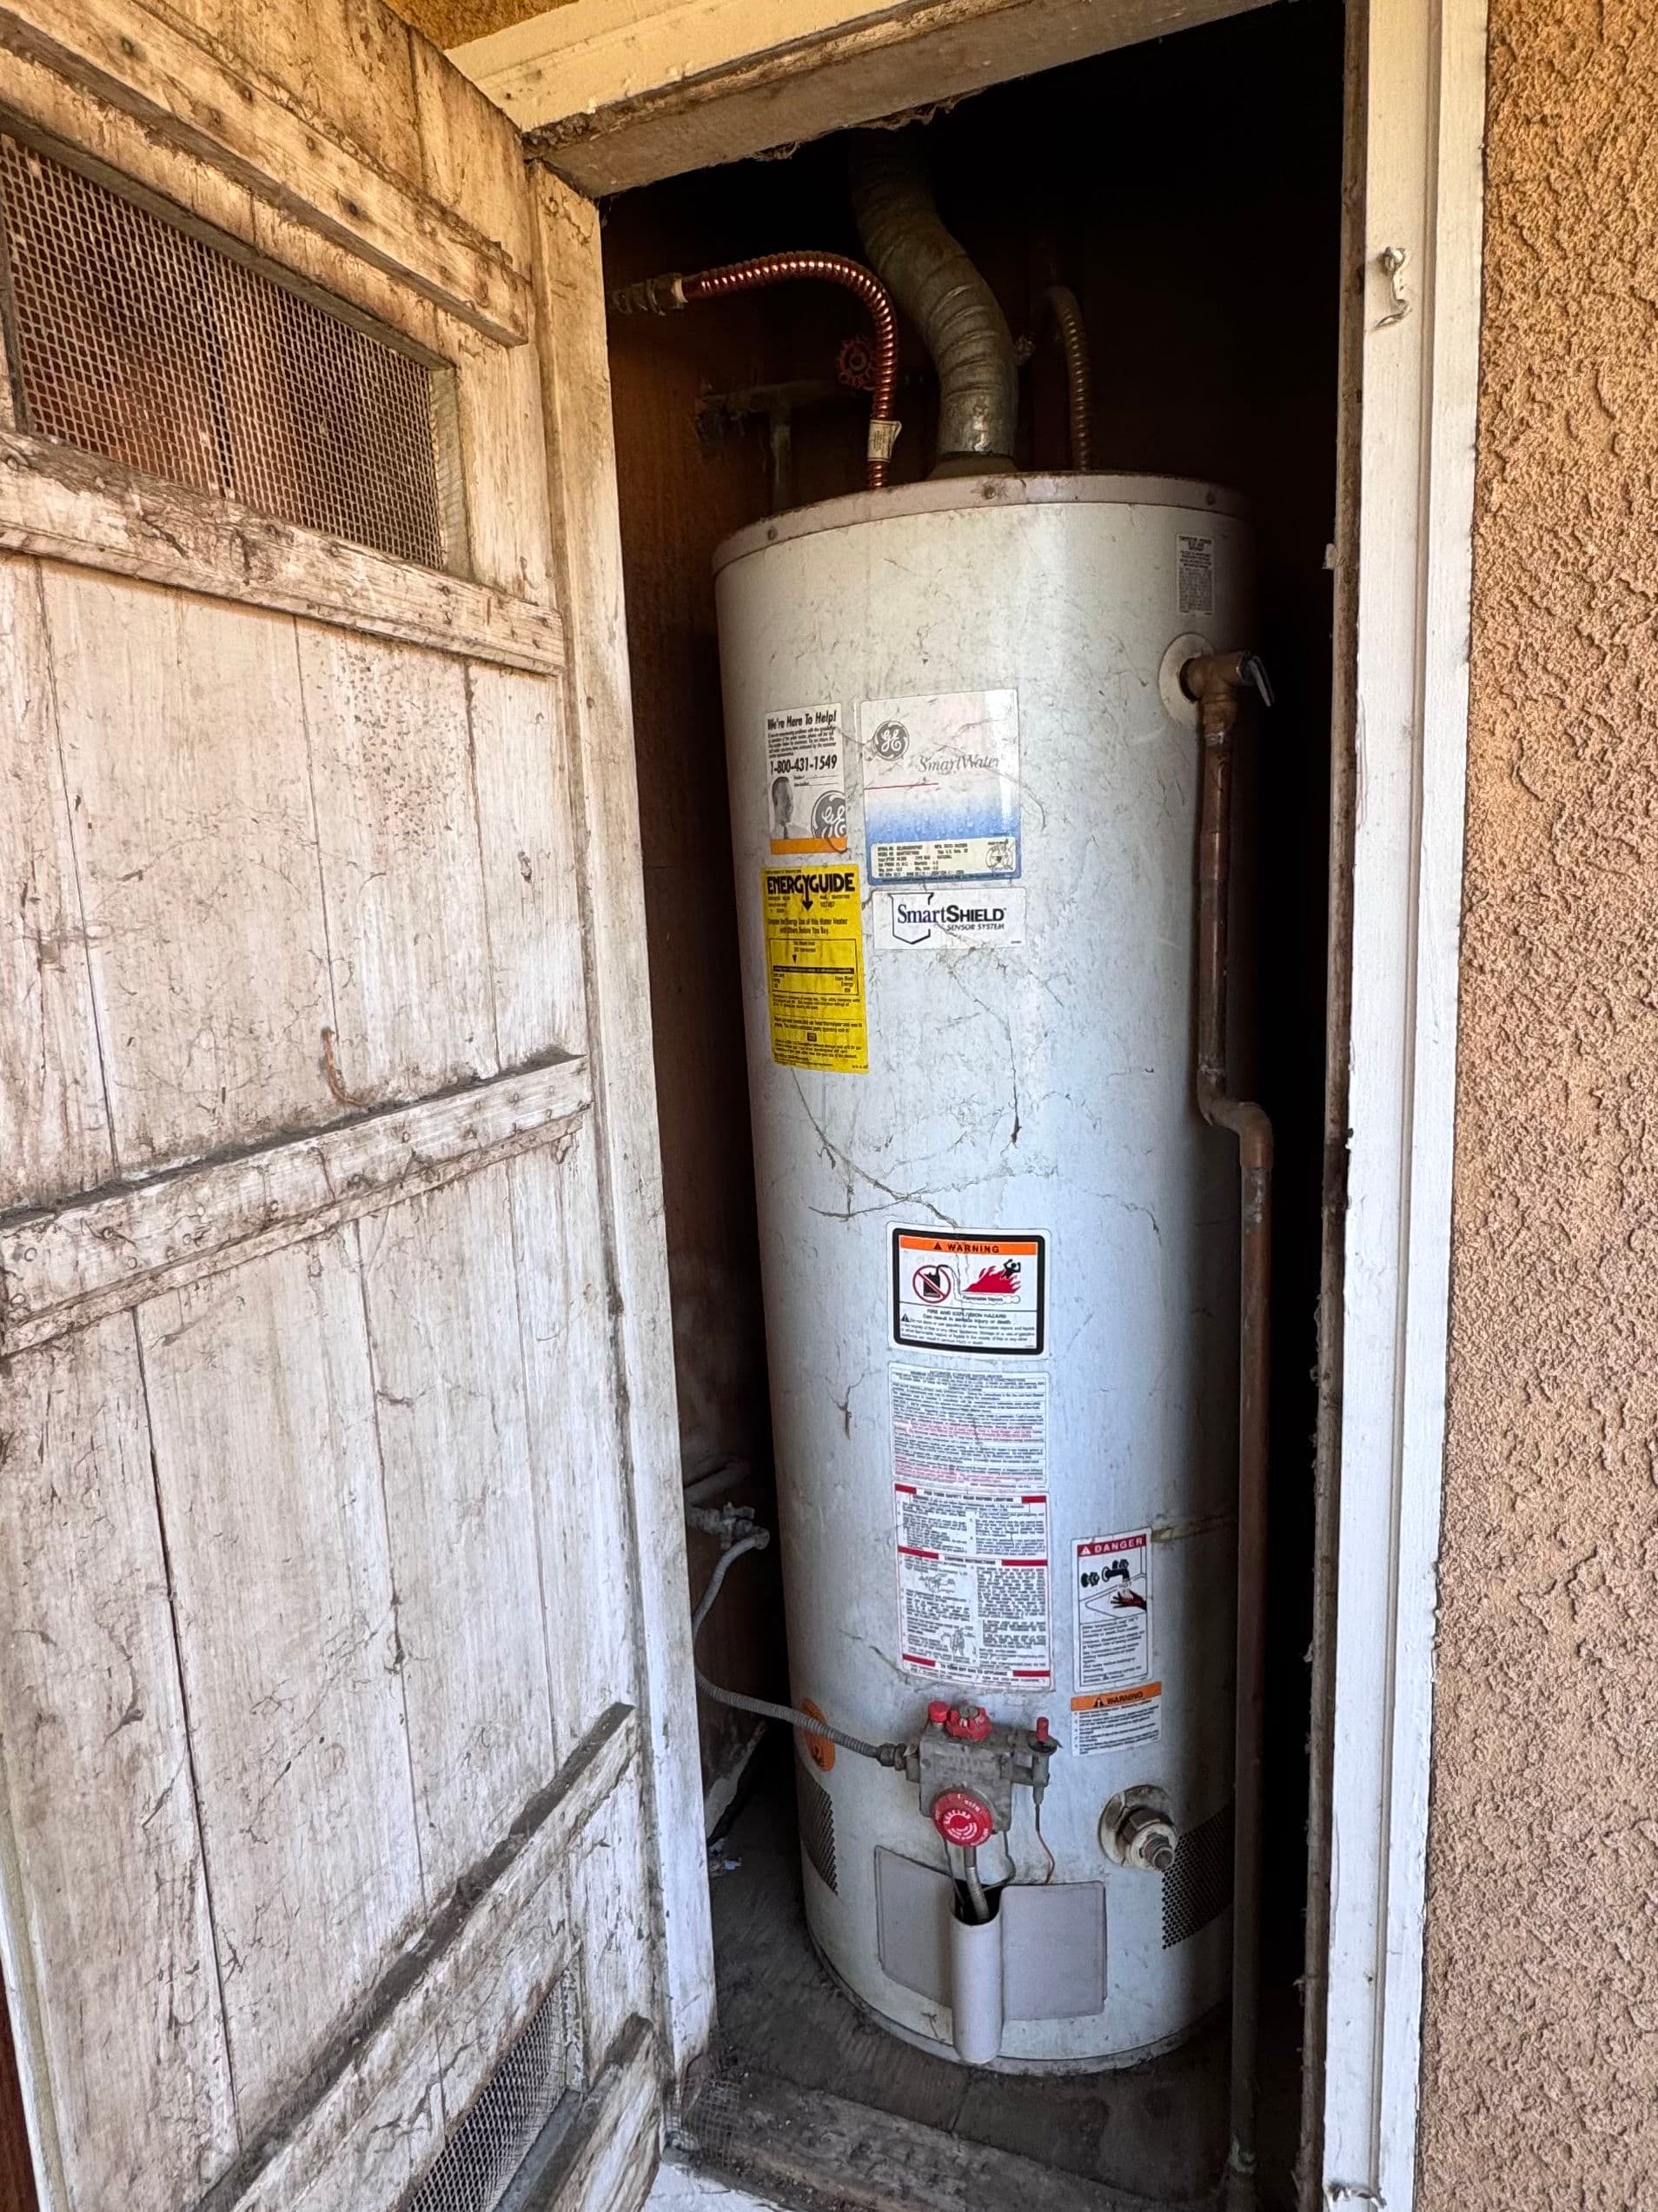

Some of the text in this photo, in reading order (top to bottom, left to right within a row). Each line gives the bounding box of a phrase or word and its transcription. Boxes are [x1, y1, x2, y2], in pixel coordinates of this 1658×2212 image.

[786, 715, 803, 727] Here
[805, 713, 812, 725] To
[815, 710, 837, 725] Help!
[770, 754, 838, 775] 1-800-431-1549
[766, 873, 856, 895] ENERGYGUIDE
[947, 1243, 999, 1253] WARNING
[1095, 1537, 1143, 1553] DANGER
[1106, 1691, 1144, 1704] WARNING
